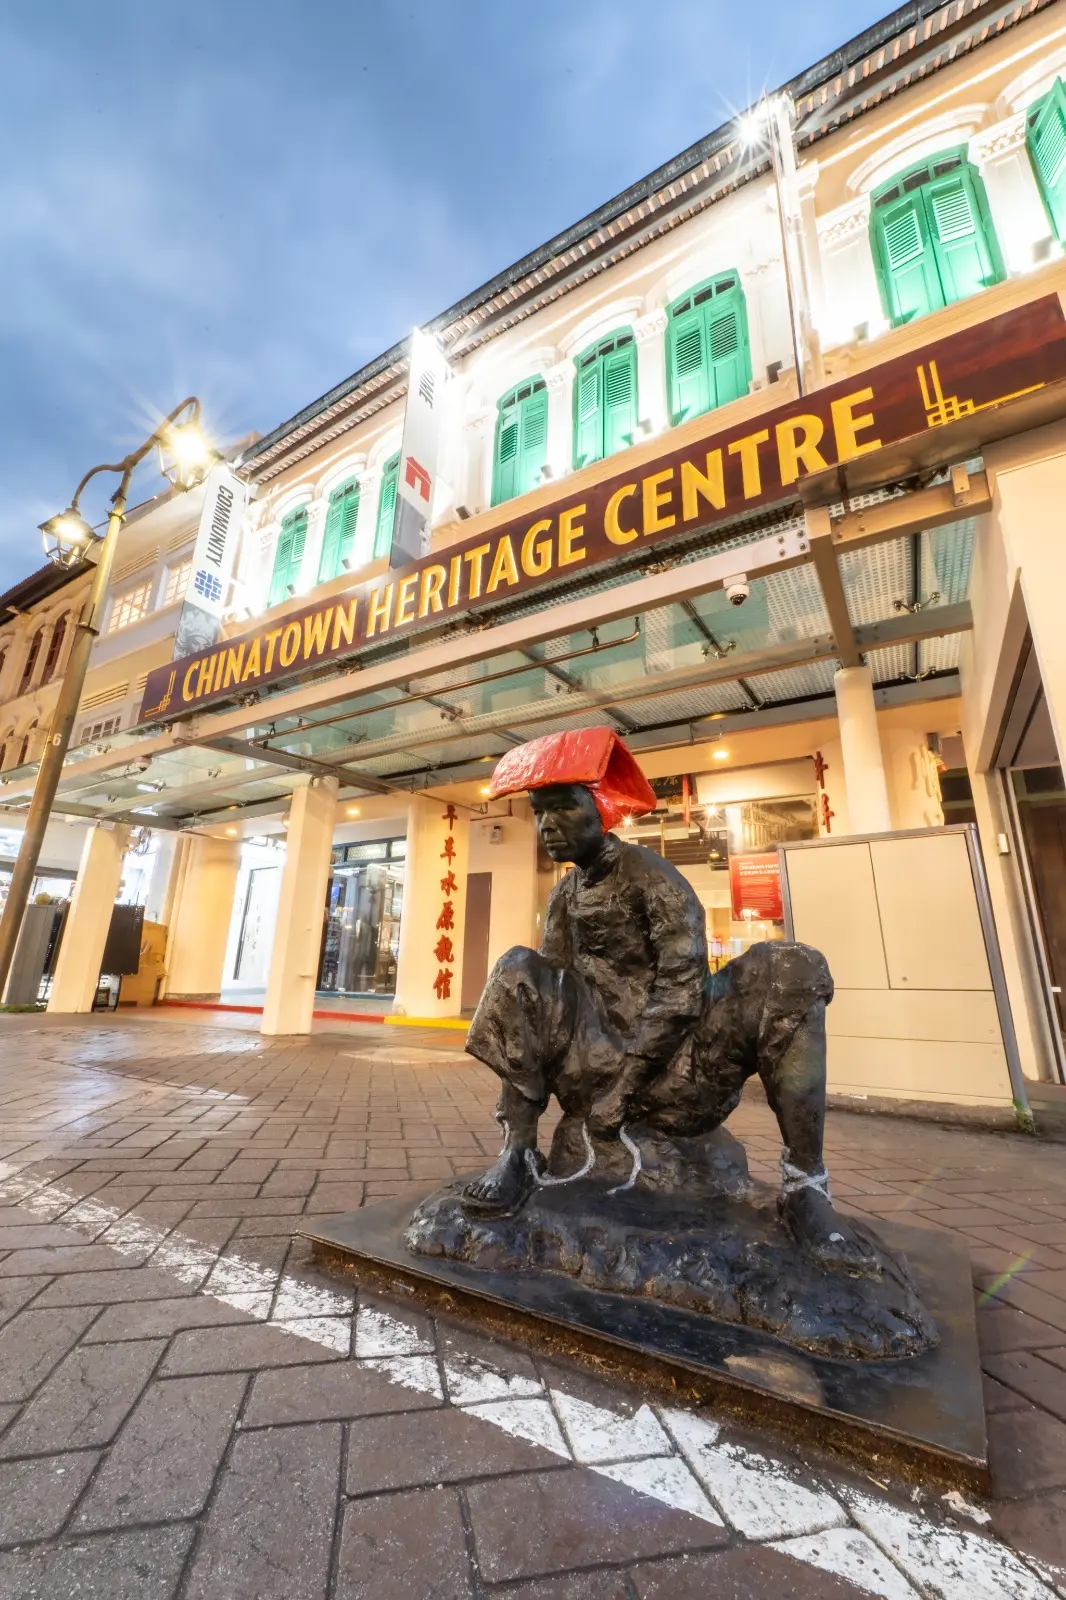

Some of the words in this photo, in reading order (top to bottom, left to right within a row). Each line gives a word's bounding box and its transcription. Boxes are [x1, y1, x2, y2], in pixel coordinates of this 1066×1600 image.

[182, 597, 359, 701] CHINATOWN
[365, 503, 588, 638] HERITAGE
[603, 386, 883, 546] CENTRE
[206, 484, 234, 568] COMMUNITY
